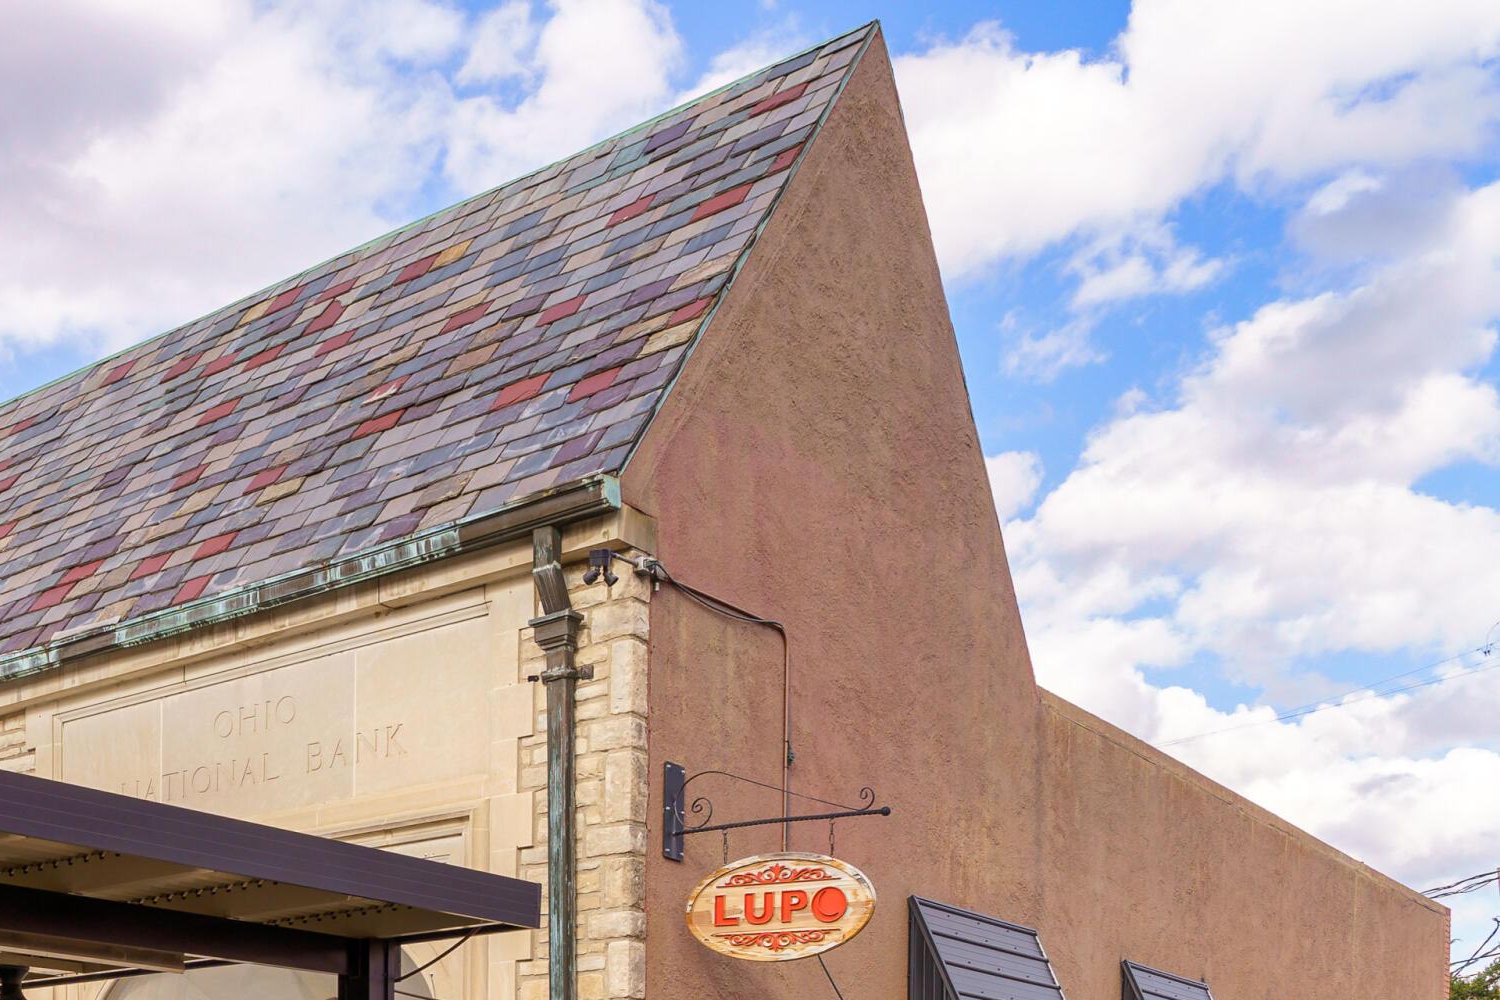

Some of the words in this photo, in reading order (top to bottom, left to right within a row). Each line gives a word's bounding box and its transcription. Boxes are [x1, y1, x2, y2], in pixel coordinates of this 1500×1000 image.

[214, 695, 297, 738] OHIO
[305, 723, 408, 775] BANK
[715, 887, 847, 926] LUPO
